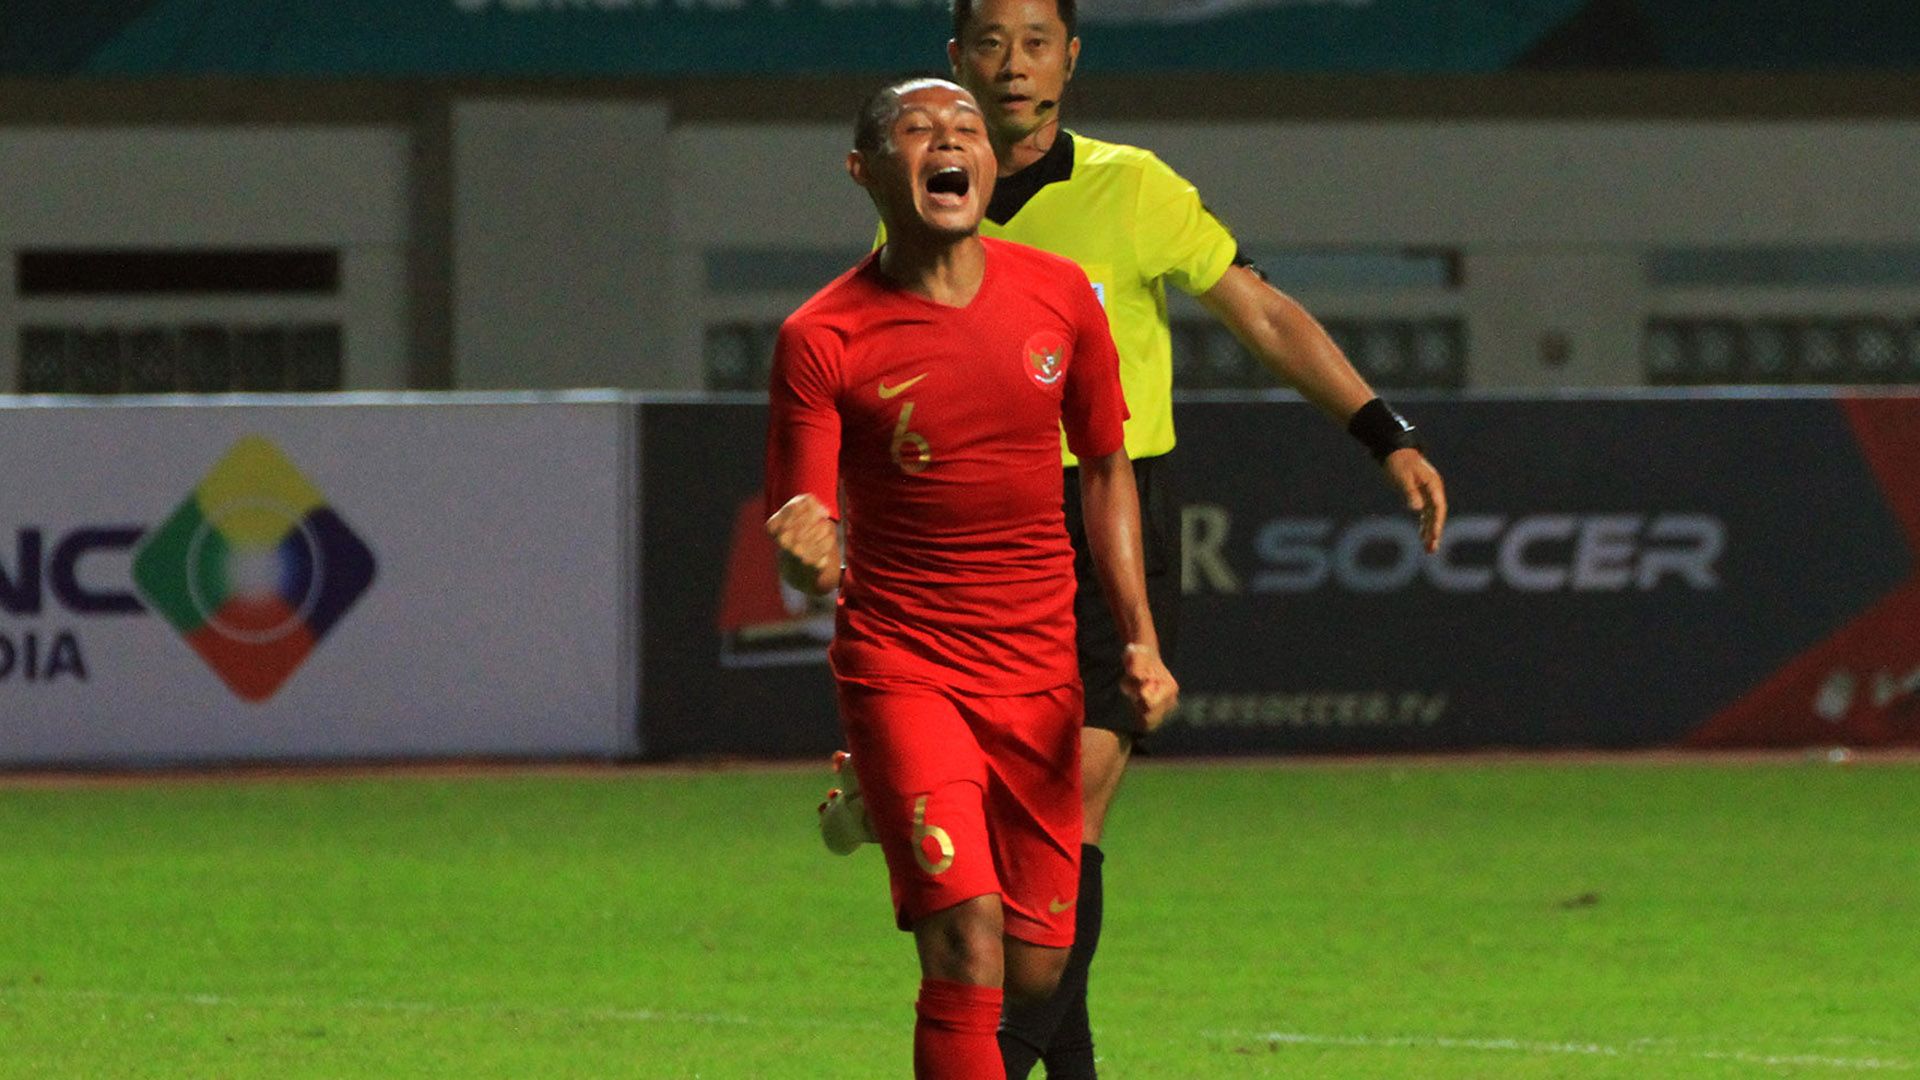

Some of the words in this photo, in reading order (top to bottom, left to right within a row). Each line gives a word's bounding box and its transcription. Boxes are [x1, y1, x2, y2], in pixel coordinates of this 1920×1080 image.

[891, 402, 932, 474] 6
[1252, 514, 1725, 590] SOCCER
[912, 796, 955, 875] 6
